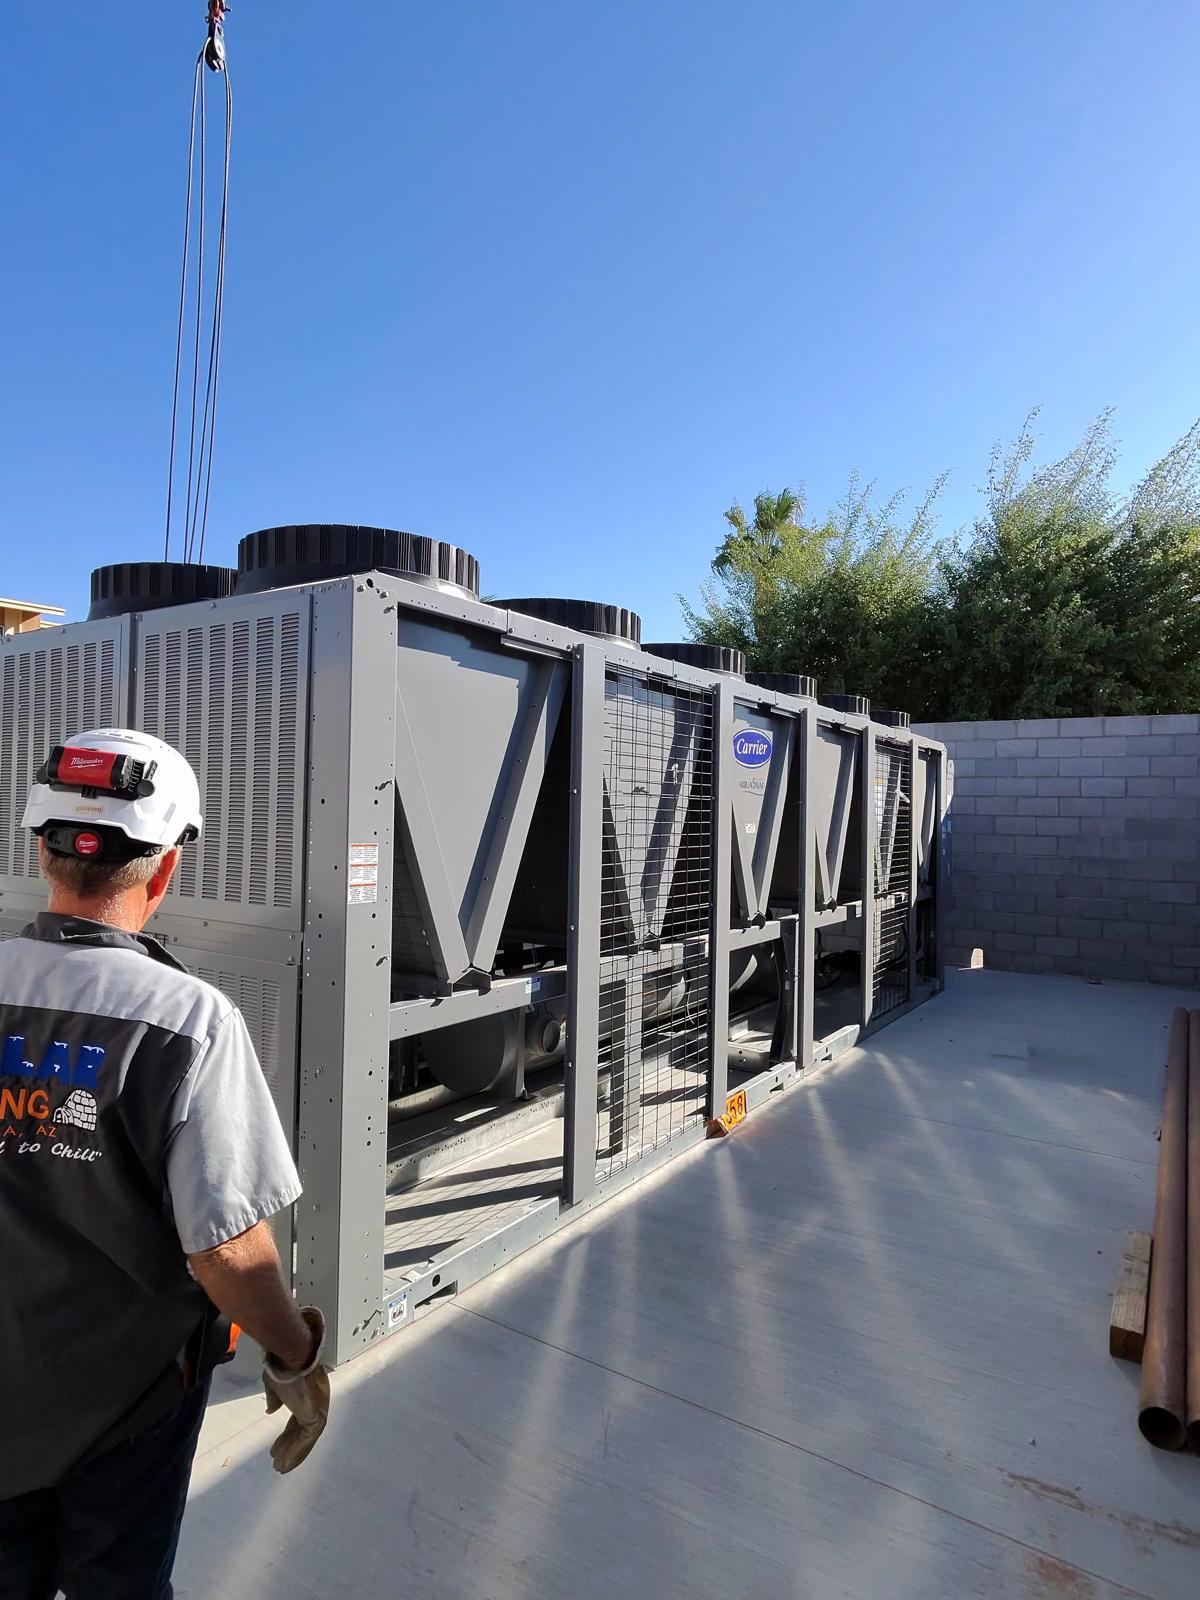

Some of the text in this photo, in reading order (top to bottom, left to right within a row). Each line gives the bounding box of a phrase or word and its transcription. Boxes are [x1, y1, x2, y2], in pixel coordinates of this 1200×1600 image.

[736, 738, 768, 755] Carrier
[36, 1125, 57, 1138] AZ
[18, 1141, 41, 1154] to
